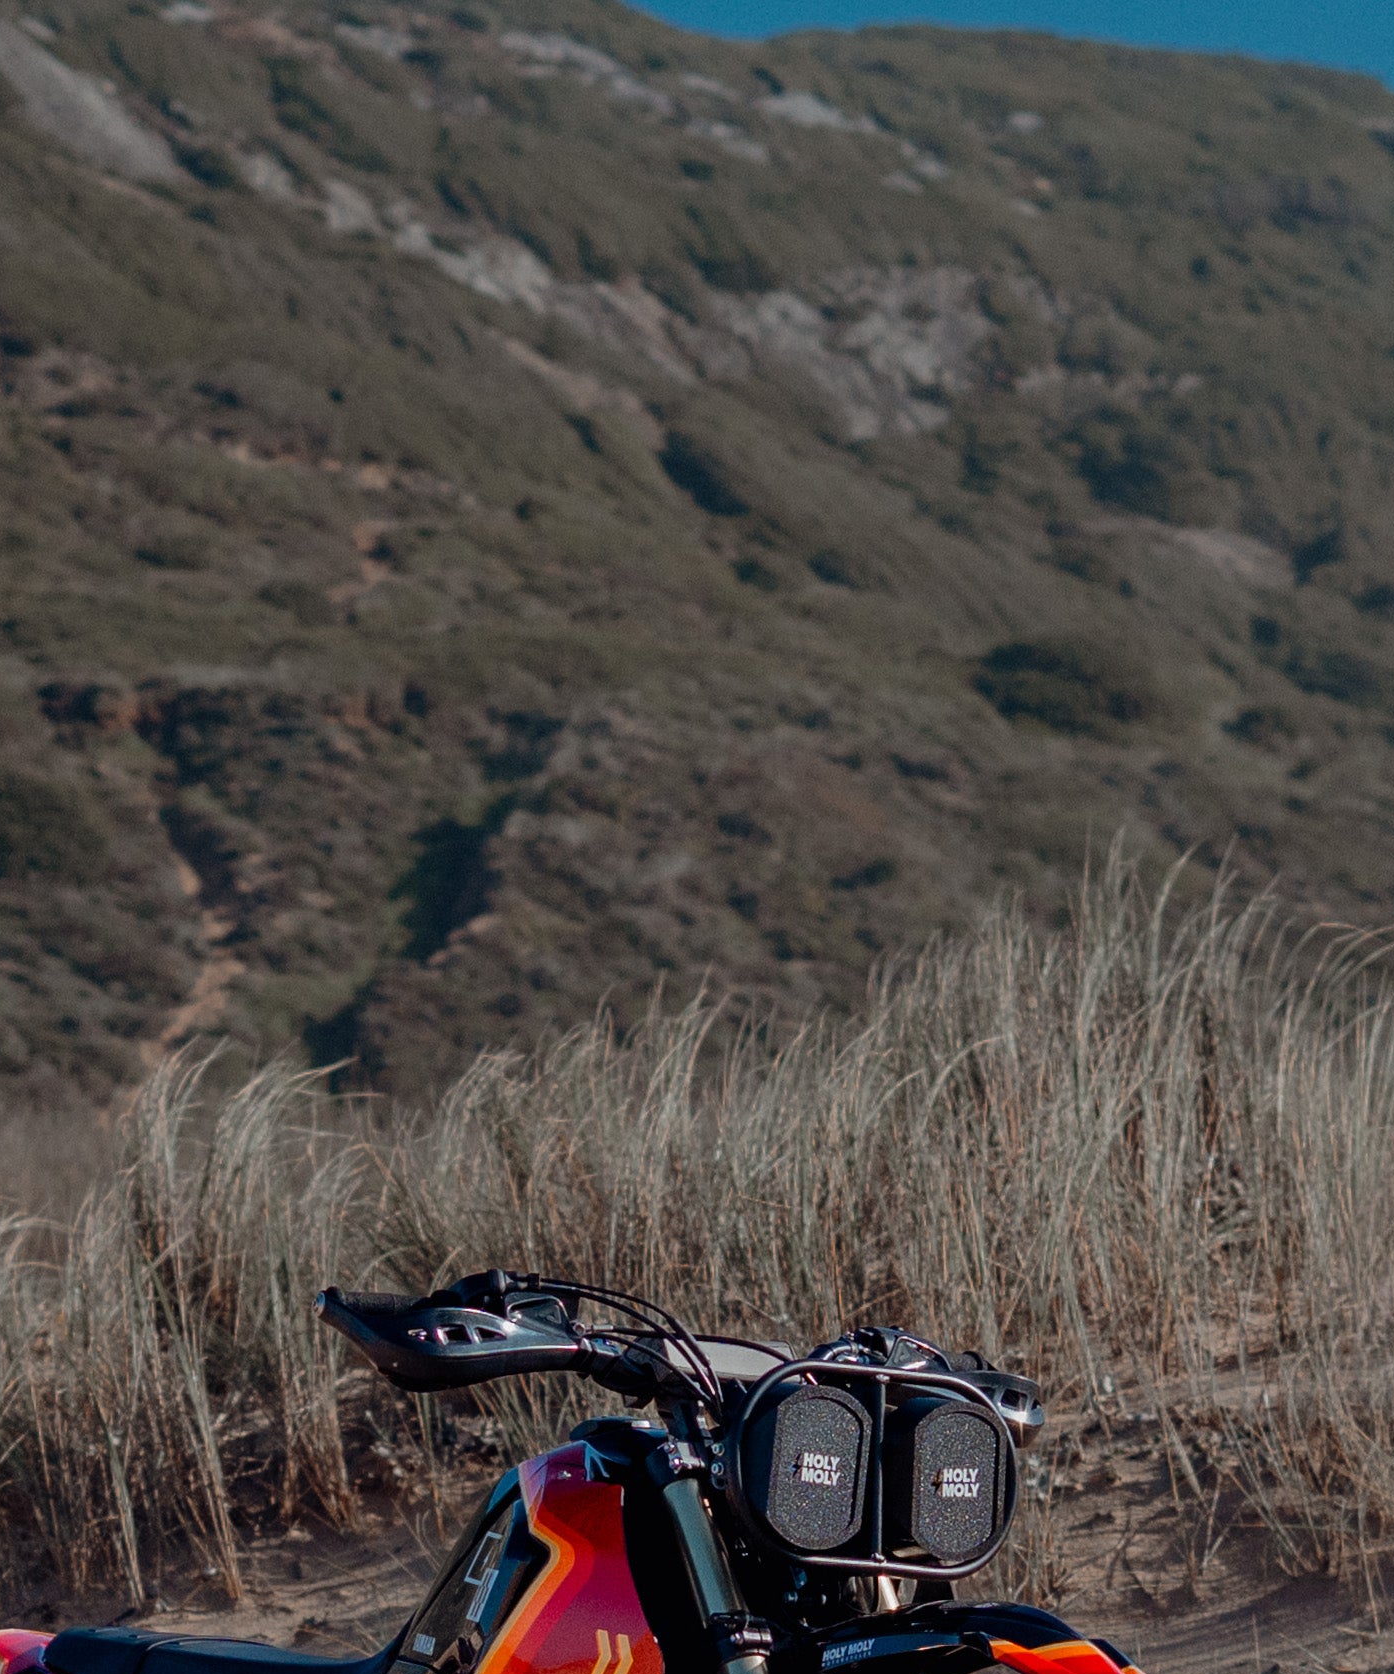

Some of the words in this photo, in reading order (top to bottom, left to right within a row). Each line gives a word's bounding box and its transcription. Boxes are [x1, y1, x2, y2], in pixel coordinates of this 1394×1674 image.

[803, 1452, 841, 1471] HOLY
[801, 1467, 841, 1486] MOLY
[943, 1468, 979, 1483] HOLY
[942, 1483, 980, 1498] MOLY
[822, 1645, 847, 1662] HOLY
[848, 1638, 875, 1655] MOLY
